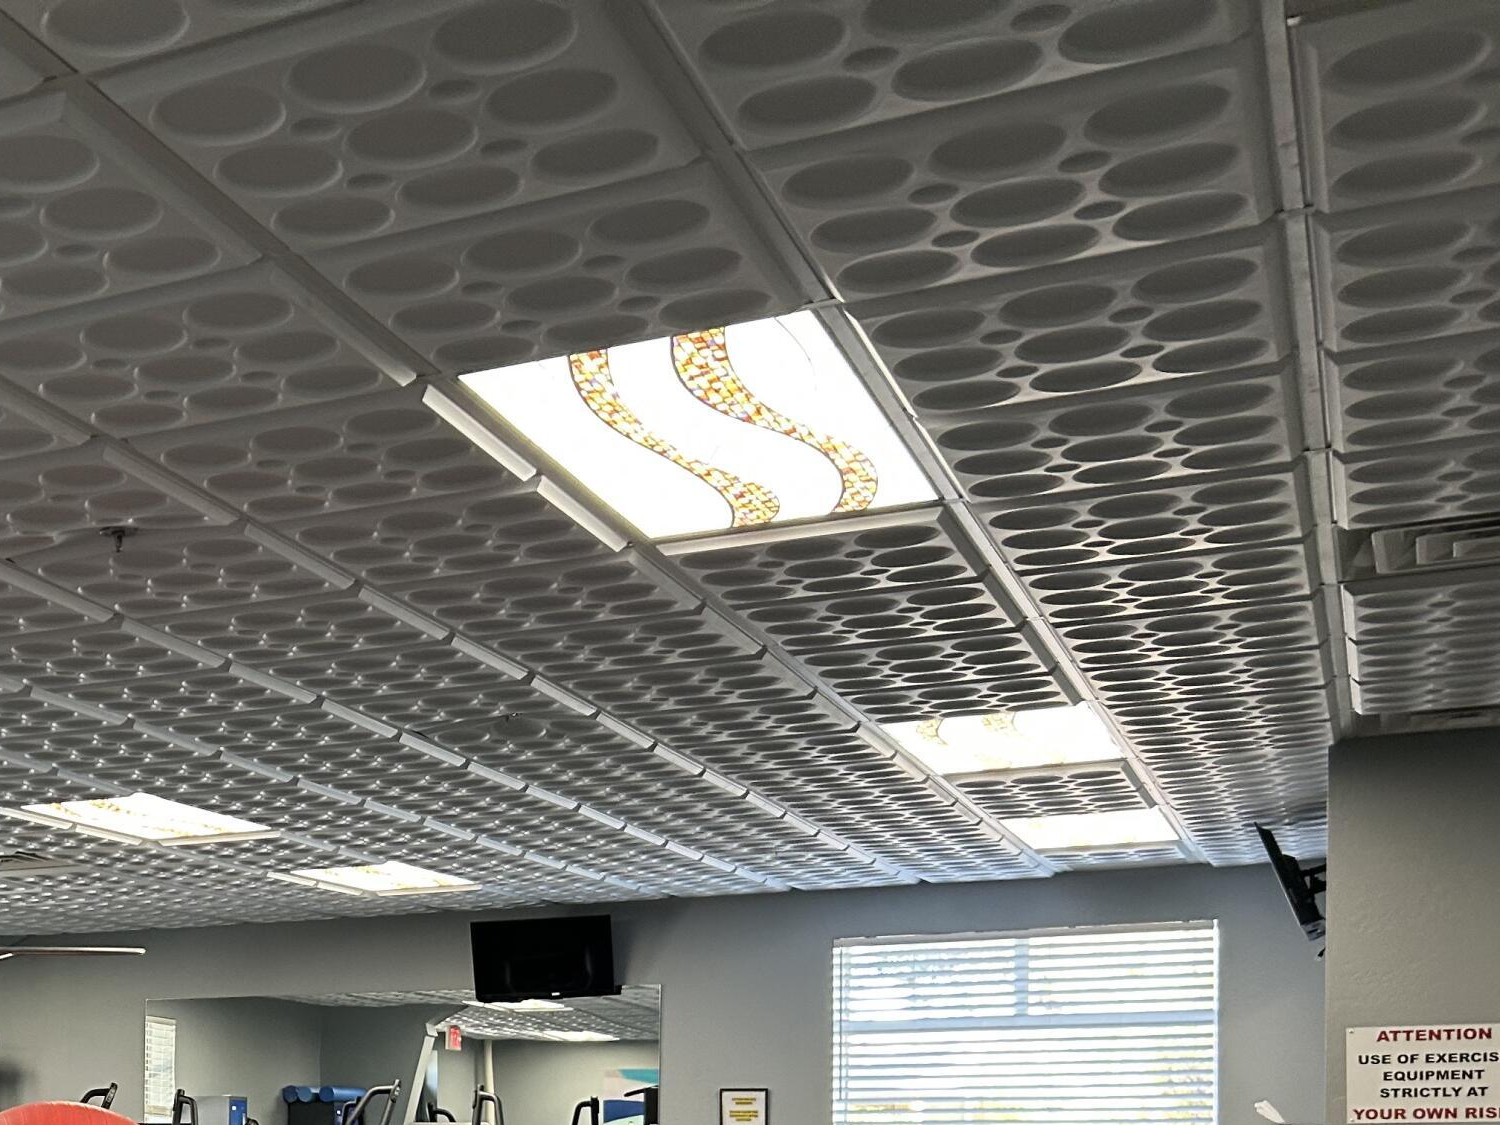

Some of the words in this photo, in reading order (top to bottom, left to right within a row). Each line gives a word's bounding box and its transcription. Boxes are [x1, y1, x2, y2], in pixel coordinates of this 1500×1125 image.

[1376, 1027, 1493, 1042] ATTENTION
[1358, 1054, 1392, 1065] USE
[1397, 1053, 1419, 1064] OF
[1425, 1051, 1500, 1063] EXERCIS
[1382, 1069, 1486, 1081] EQUIPMENT
[1380, 1087, 1462, 1098] STRICTLY
[1466, 1086, 1489, 1097] AT
[1353, 1108, 1407, 1120] YOUR
[1412, 1107, 1458, 1119] OWN
[1465, 1106, 1500, 1119] RIS
